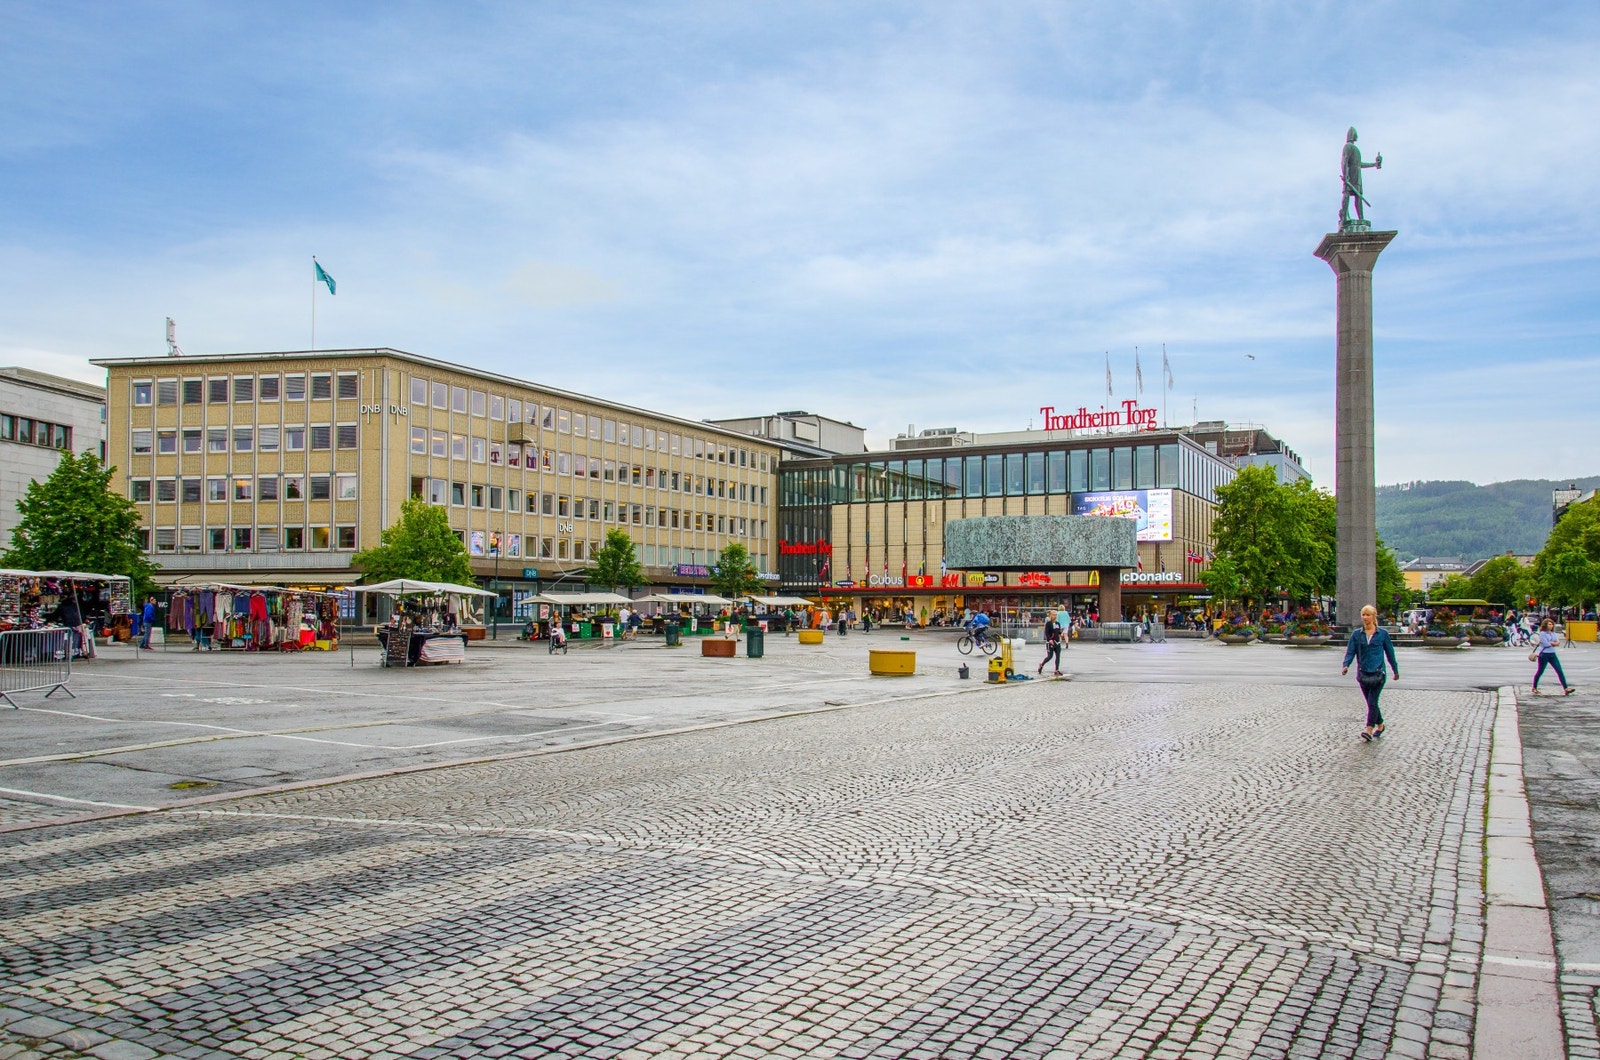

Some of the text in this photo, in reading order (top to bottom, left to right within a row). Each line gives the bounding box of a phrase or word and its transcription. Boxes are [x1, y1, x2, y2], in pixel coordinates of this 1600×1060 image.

[1040, 400, 1157, 432] Trondheim Torg
[560, 521, 573, 535] DNB
[779, 540, 817, 555] Trondheim
[525, 569, 537, 579] DNB
[870, 574, 903, 585] Cubus
